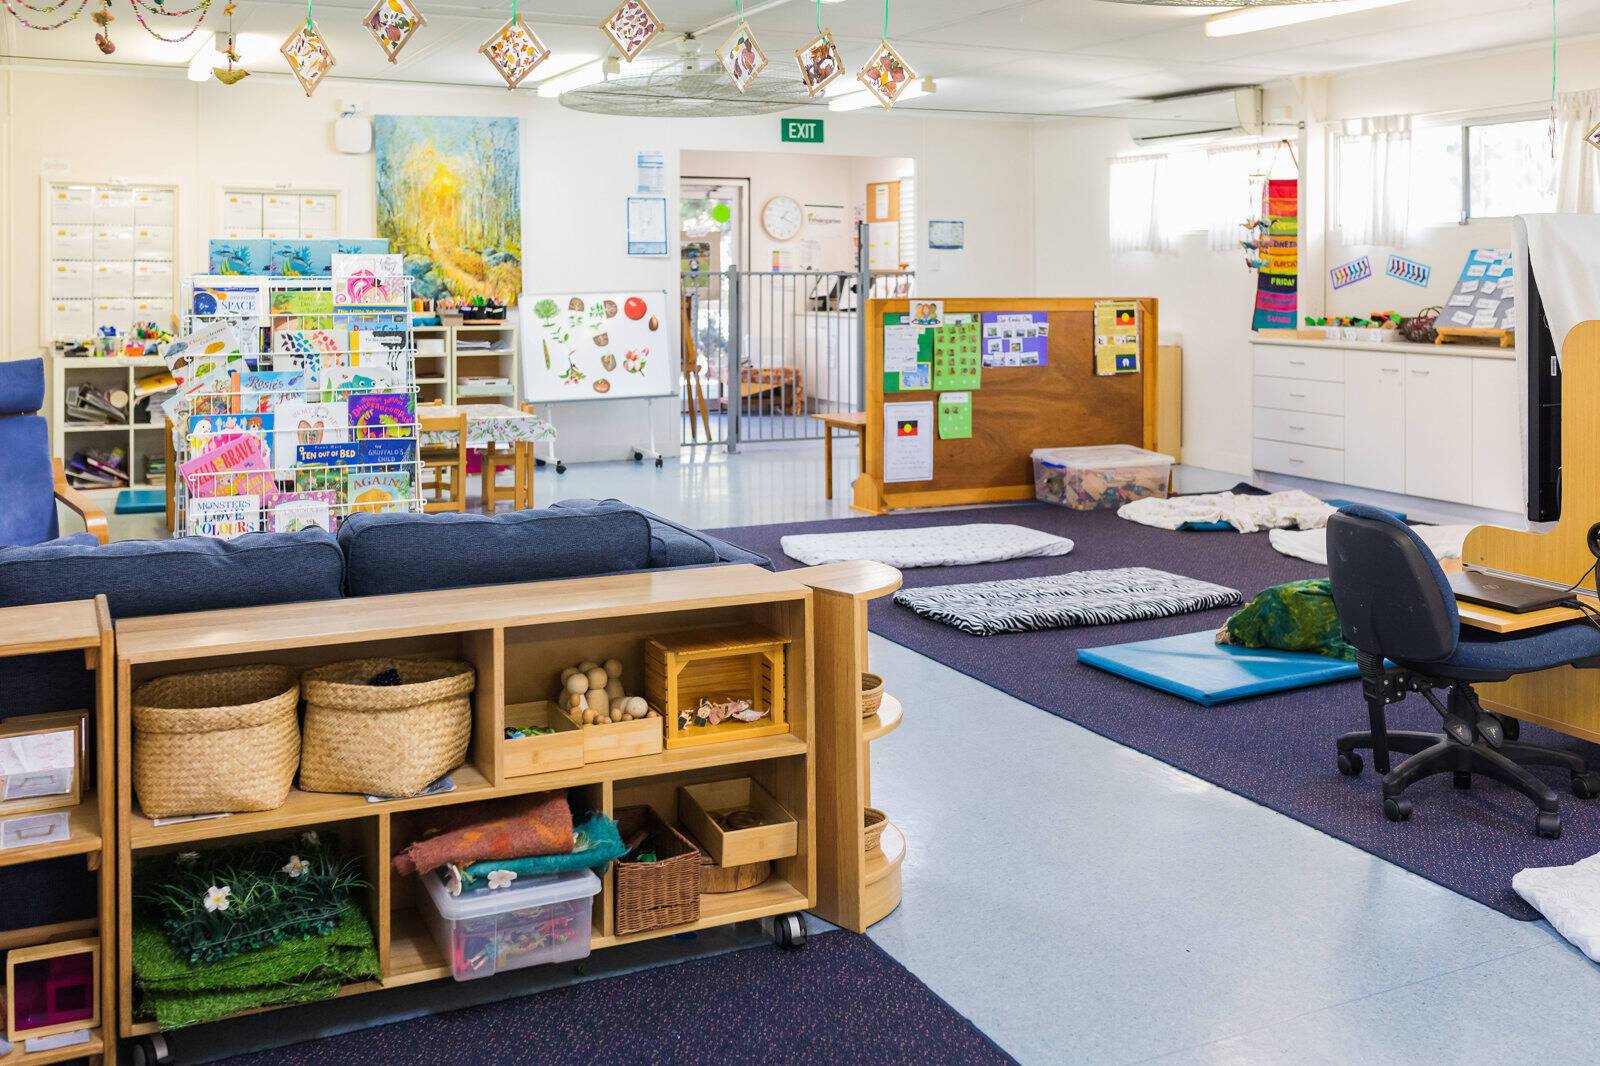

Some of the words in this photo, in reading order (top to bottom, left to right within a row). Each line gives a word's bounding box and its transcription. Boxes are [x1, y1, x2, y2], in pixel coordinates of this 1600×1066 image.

[788, 122, 817, 139] EXIT
[1270, 277, 1296, 287] FRIDAY
[221, 300, 256, 311] SPACE
[244, 375, 285, 391] Rosie's
[220, 438, 257, 469] BRAVE
[300, 451, 317, 460] TEN
[317, 451, 330, 459] OUT
[339, 449, 356, 459] BED
[368, 448, 404, 456] GRUFFALO'S
[197, 499, 252, 511] MONSTERS
[193, 520, 256, 535] COLOURS
